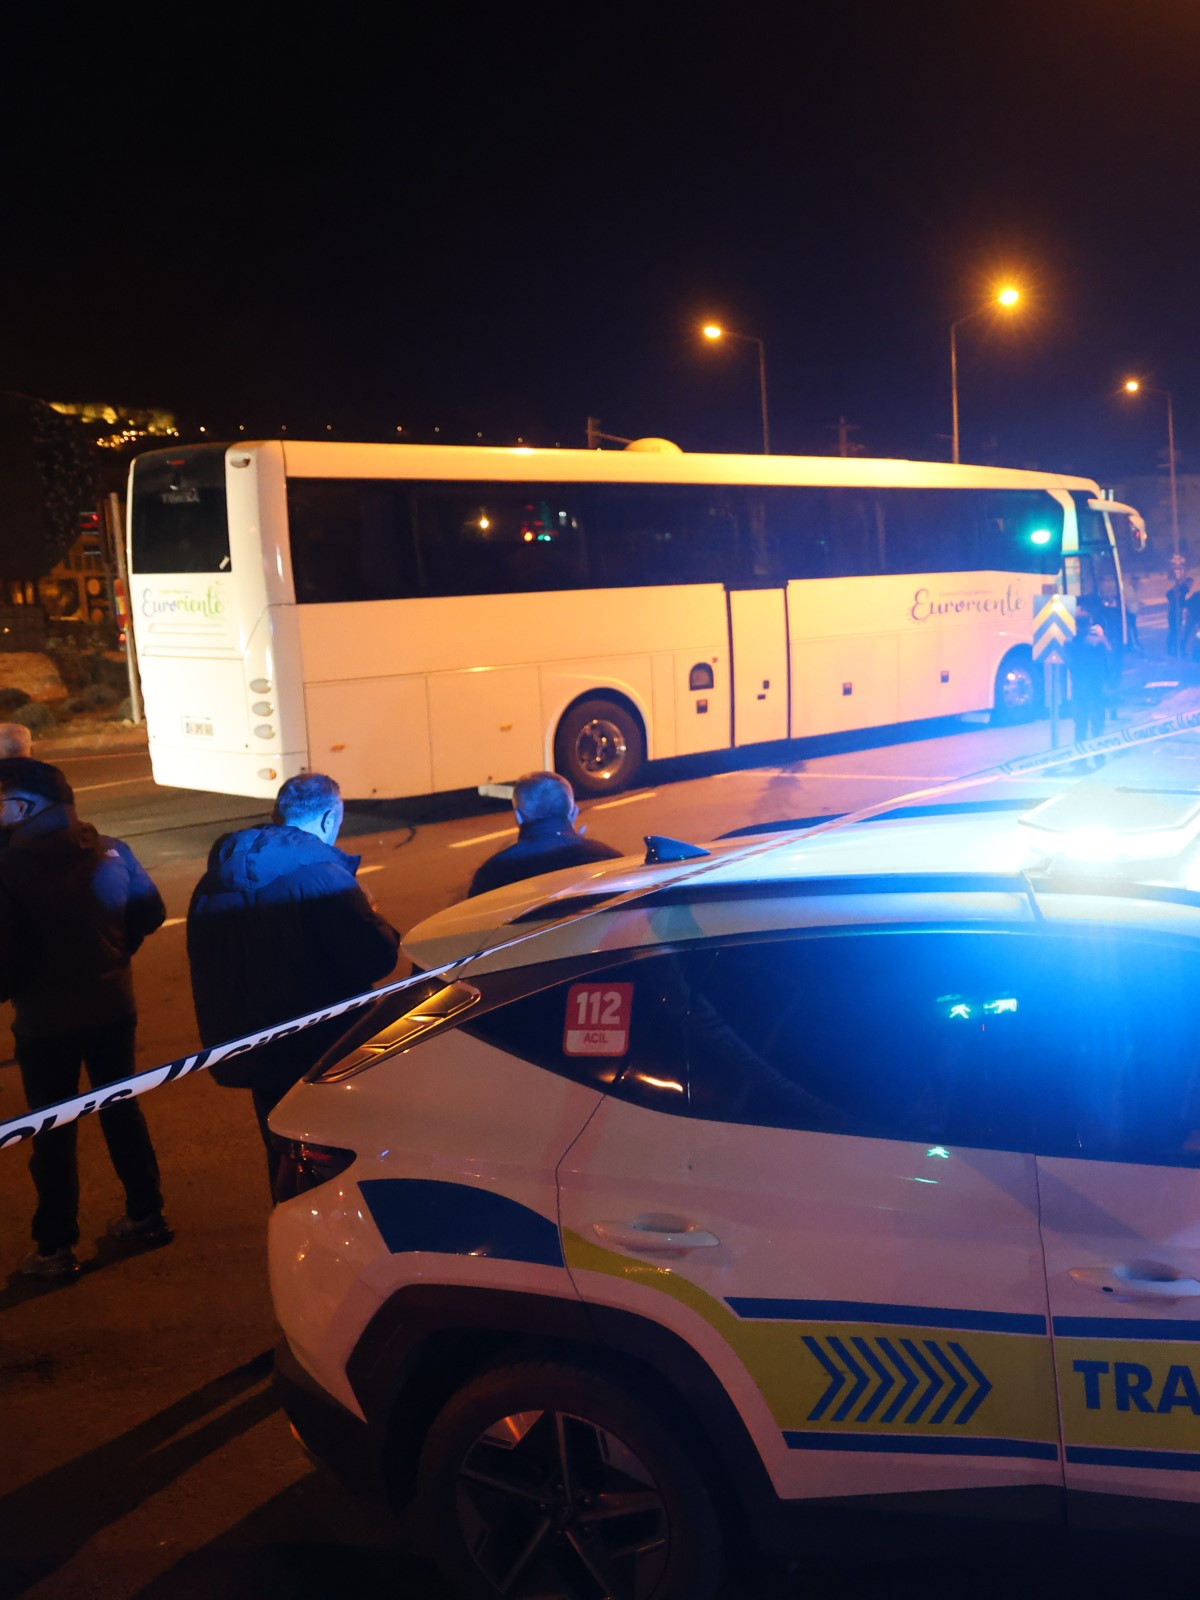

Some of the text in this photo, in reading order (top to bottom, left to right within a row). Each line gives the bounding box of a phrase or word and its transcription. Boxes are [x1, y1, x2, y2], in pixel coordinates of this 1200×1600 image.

[141, 582, 222, 617] Euroriente
[911, 582, 1025, 622] Euroriente
[576, 990, 622, 1025] 112
